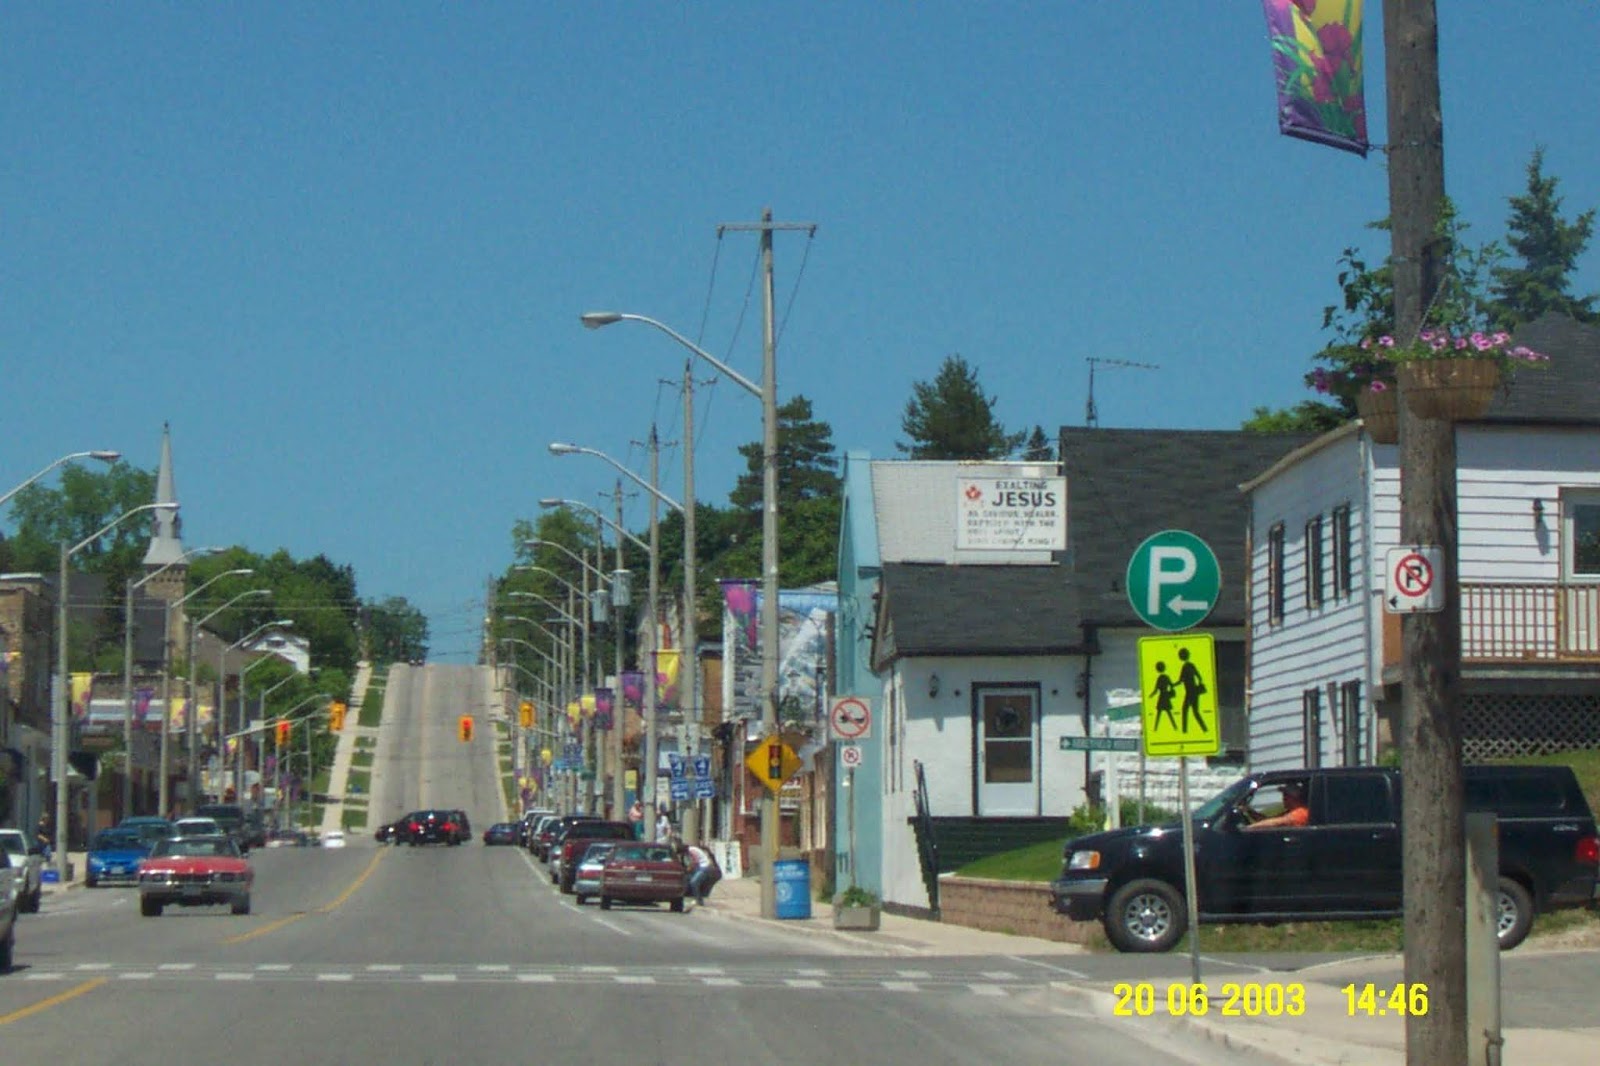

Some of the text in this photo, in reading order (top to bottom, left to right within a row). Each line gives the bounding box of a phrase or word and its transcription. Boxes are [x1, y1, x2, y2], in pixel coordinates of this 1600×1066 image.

[995, 481, 1048, 490] EXALTING
[991, 492, 1057, 508] JESUS
[1147, 546, 1197, 615] P
[1406, 566, 1422, 588] P
